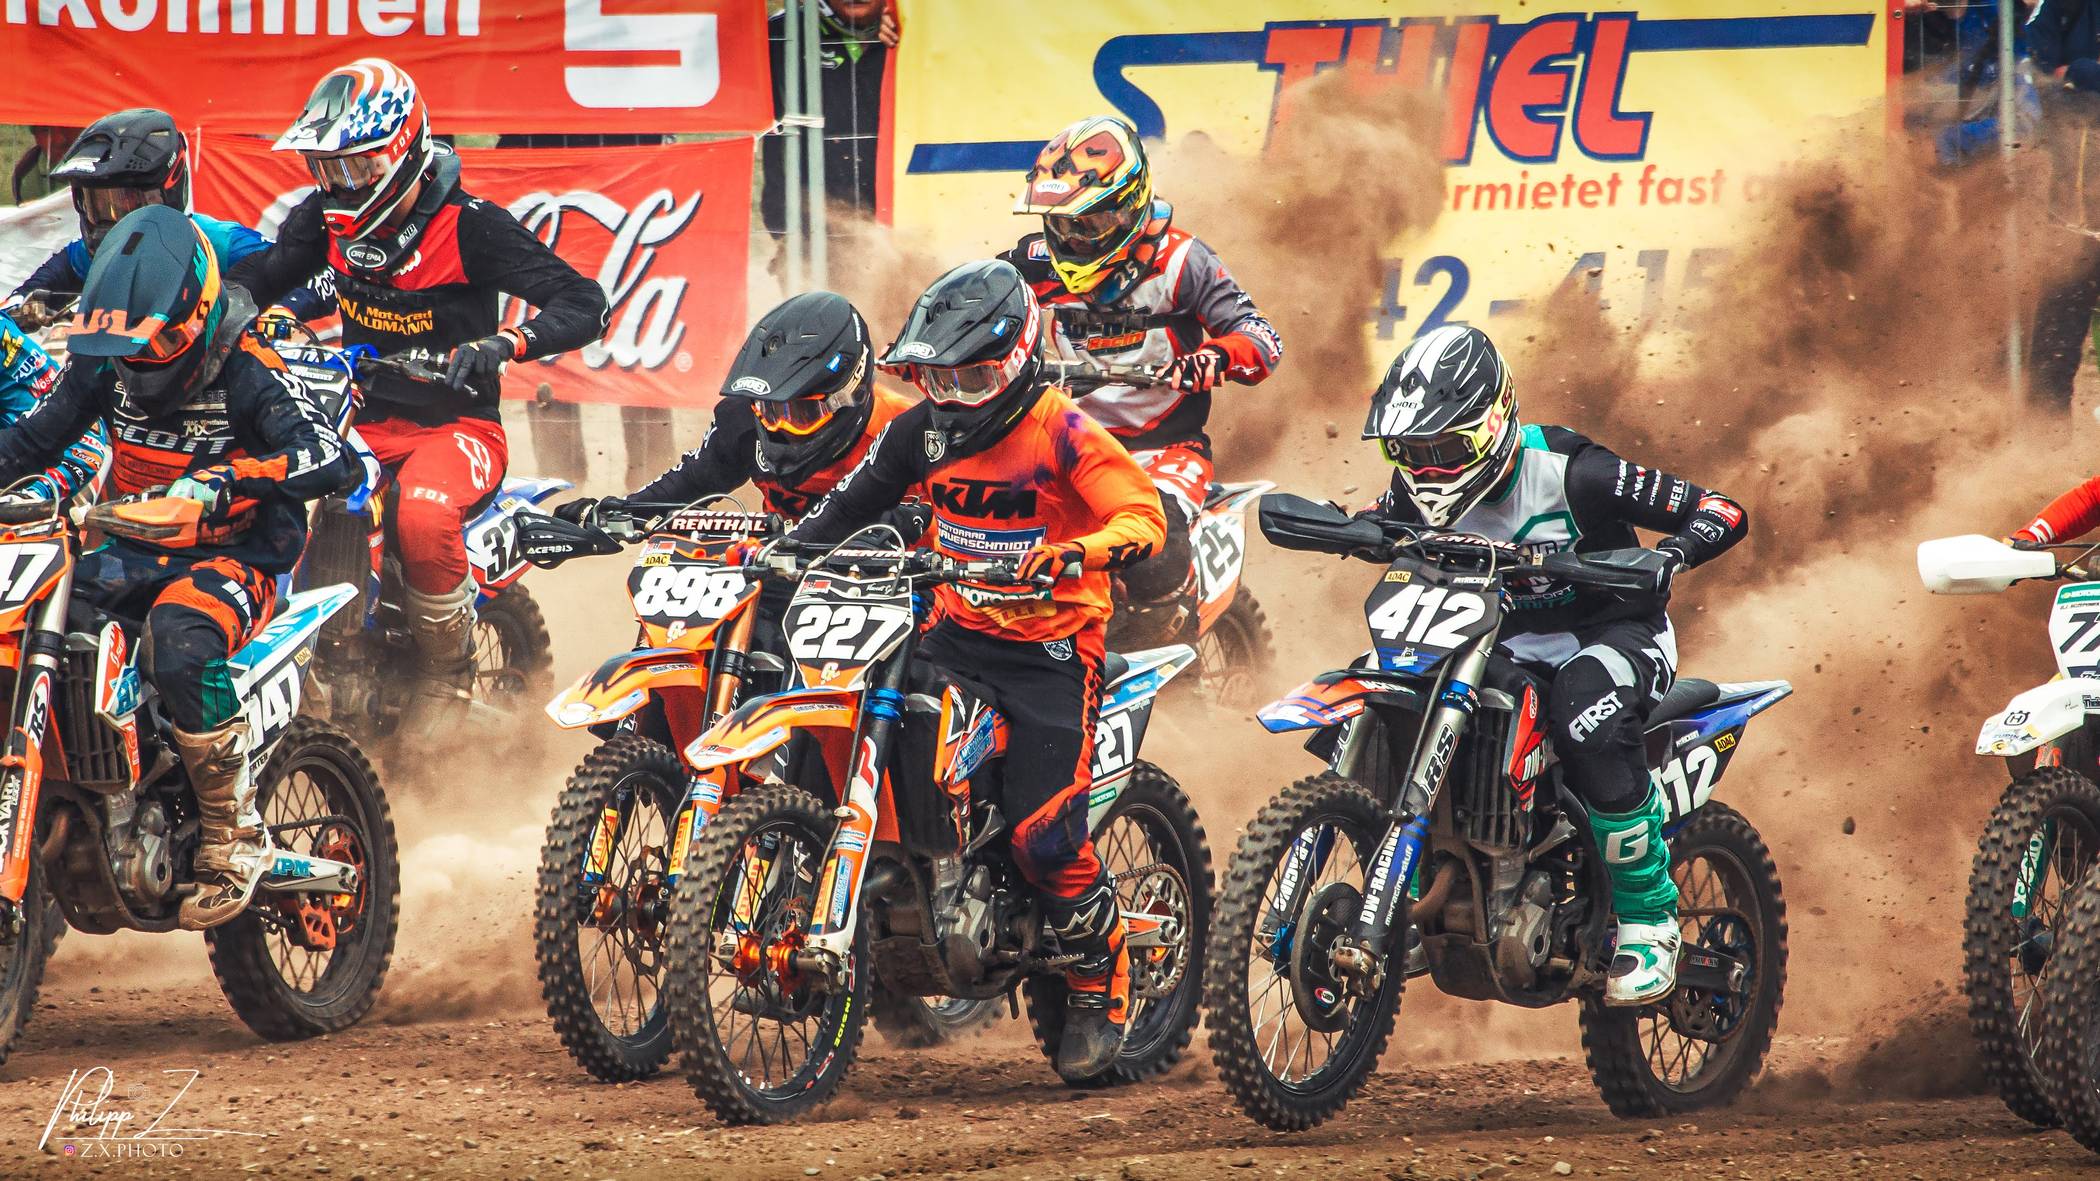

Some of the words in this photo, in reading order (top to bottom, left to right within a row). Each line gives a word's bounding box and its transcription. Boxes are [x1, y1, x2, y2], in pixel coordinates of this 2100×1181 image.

[391, 131, 412, 156] FOX
[1637, 164, 1727, 206] fast
[336, 291, 433, 336] WALDMANN
[366, 305, 433, 323] Motorrad
[737, 380, 764, 392] SHOEI
[412, 486, 449, 505] FOX
[931, 477, 1038, 520] KTM
[671, 518, 768, 532] RENTHAL
[633, 565, 747, 620] 898
[790, 604, 911, 661] 227
[1369, 583, 1486, 650] 412
[1568, 690, 1624, 743] FIRST
[1091, 711, 1133, 779] 27
[1606, 820, 1649, 864] G
[834, 996, 852, 1048] INSIDE
